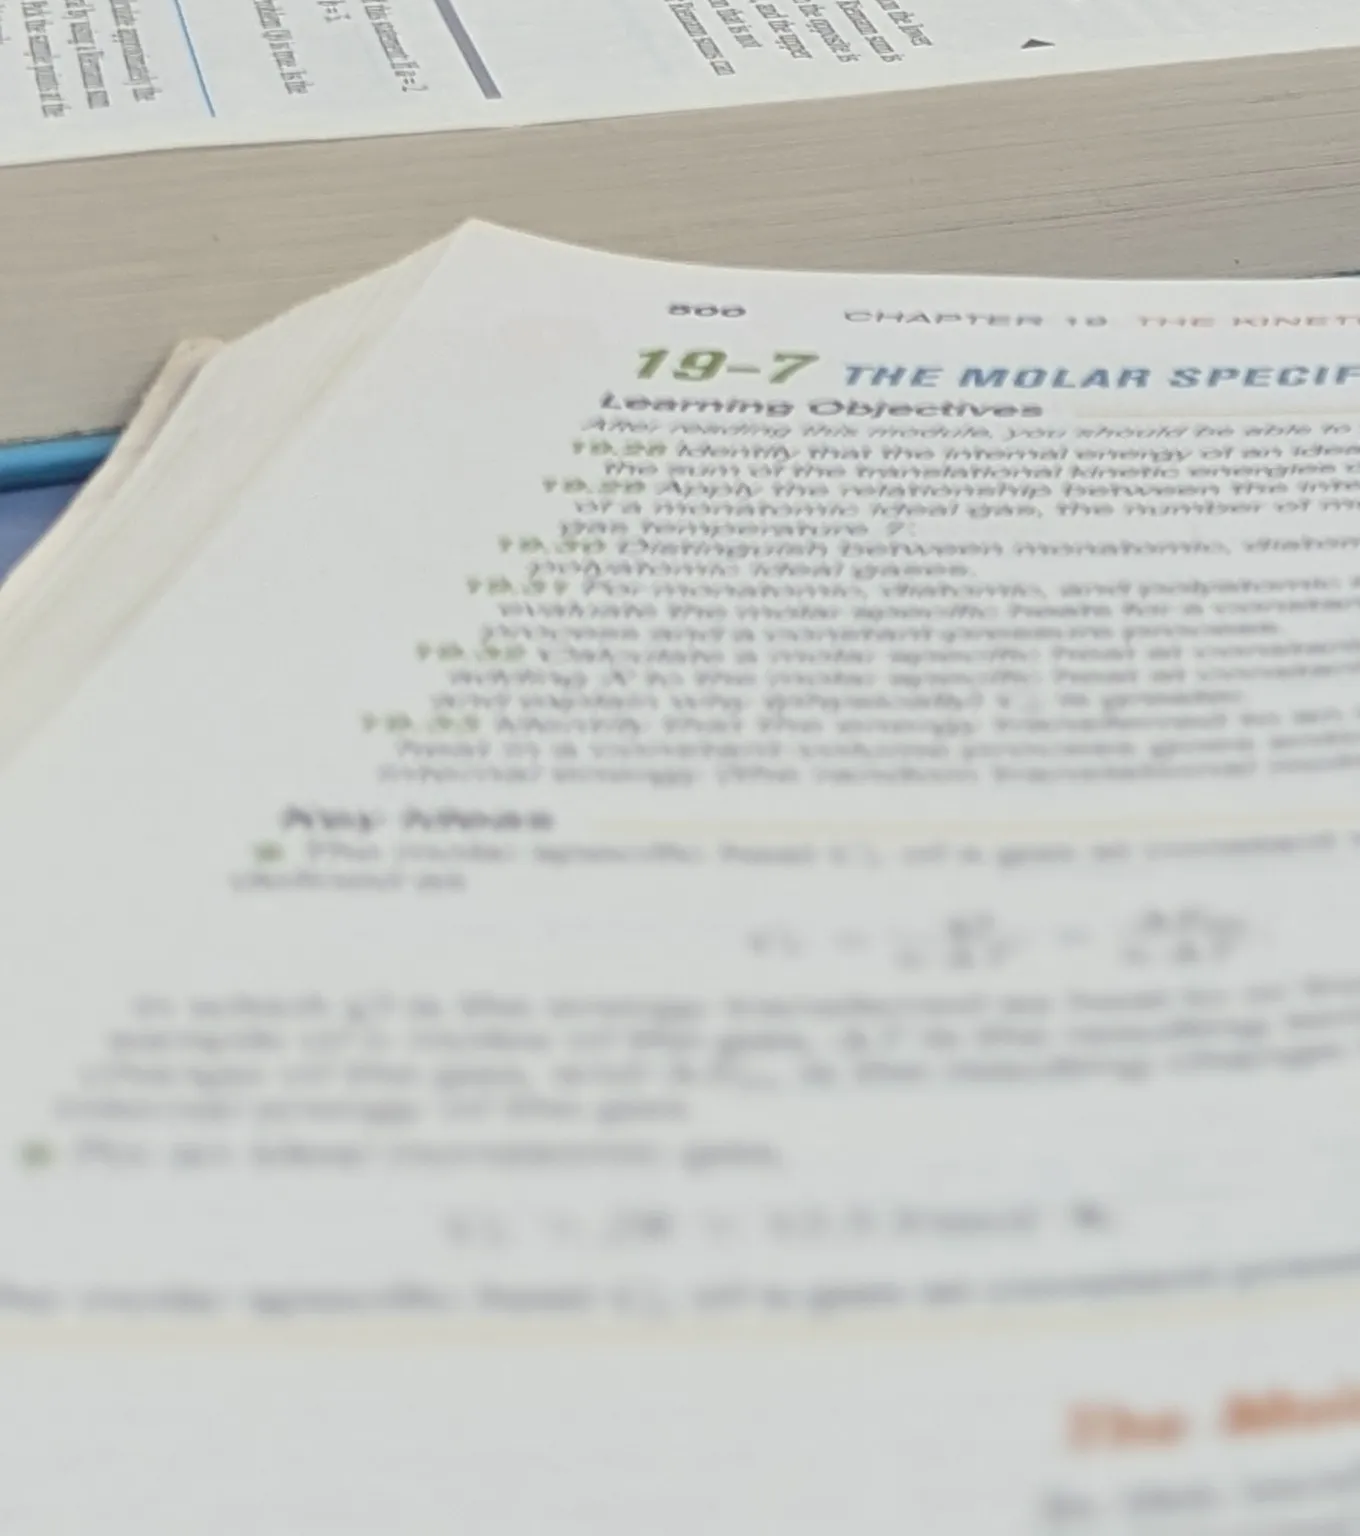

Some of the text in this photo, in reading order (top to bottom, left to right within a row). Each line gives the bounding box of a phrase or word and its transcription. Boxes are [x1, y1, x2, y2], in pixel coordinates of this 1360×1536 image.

[843, 309, 1043, 328] CHAPTER
[1138, 314, 1216, 328] THE
[635, 347, 820, 385] 19-7
[843, 366, 943, 388] THE
[958, 367, 1152, 389] MOLAR
[600, 390, 1044, 418] Learning Objectives
